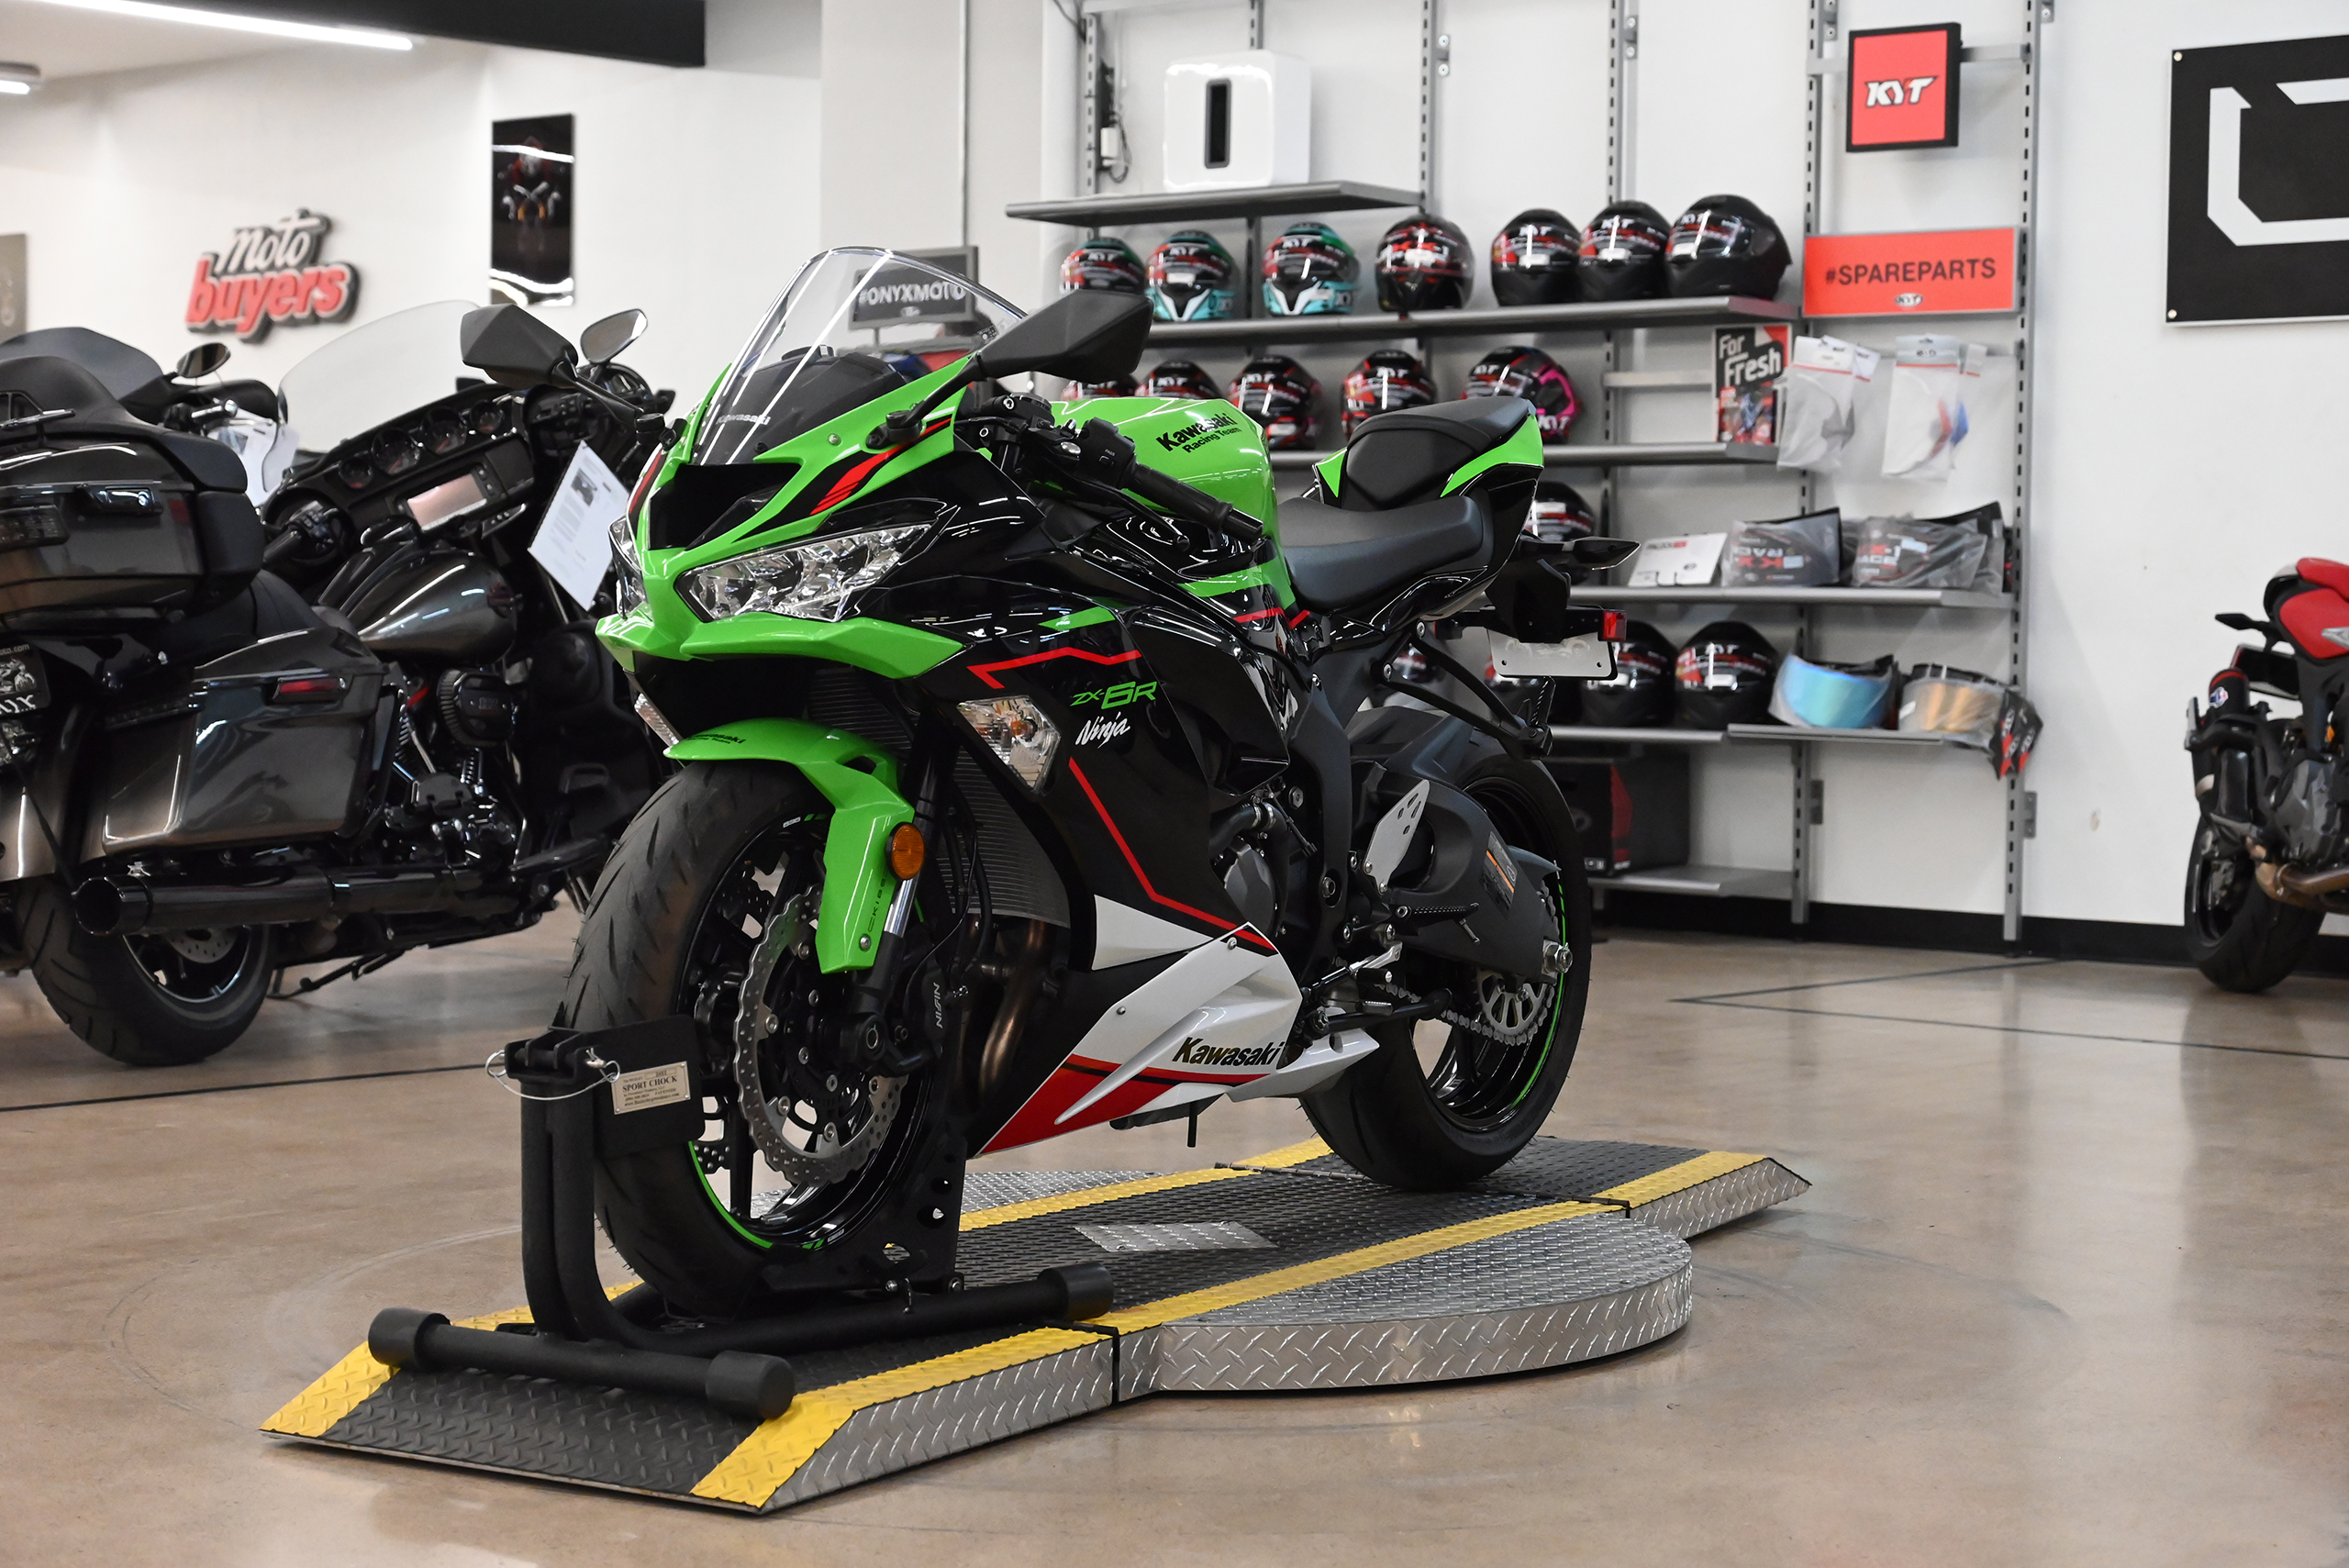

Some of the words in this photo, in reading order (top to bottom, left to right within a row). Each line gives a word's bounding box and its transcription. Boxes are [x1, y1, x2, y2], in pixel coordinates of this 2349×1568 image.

[1865, 75, 1940, 107] KYT
[1825, 258, 1997, 286] #SPAREPARTS
[185, 256, 350, 338] buyers
[1719, 333, 1746, 361] For
[1724, 348, 1782, 386] Fresh
[1156, 413, 1238, 451] Kawasaki
[1182, 433, 1220, 453] Racing
[1217, 427, 1242, 438] Team
[1069, 681, 1157, 710] ZX-6R
[1074, 711, 1130, 750] Ninja
[932, 982, 943, 1029] NISSIN
[1172, 1037, 1286, 1067] Kawasaki
[622, 1081, 647, 1092] SPORT
[649, 1075, 677, 1087] CHOCK
